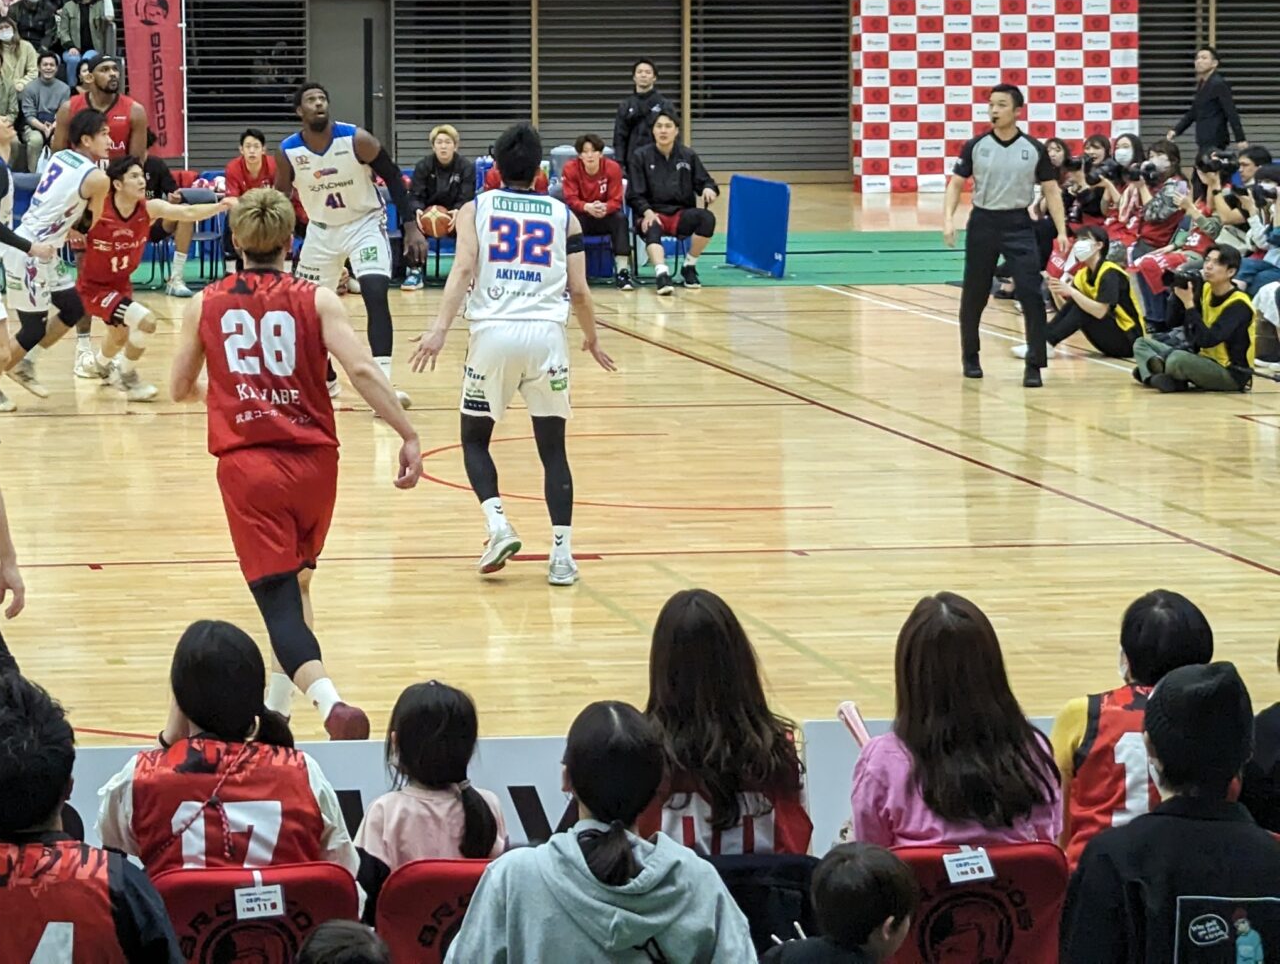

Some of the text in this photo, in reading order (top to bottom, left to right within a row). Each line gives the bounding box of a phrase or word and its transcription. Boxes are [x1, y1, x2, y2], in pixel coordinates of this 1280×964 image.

[325, 191, 346, 210] 41
[488, 214, 555, 268] 32
[495, 268, 542, 283] AKIYAMA
[221, 308, 297, 377] 28
[171, 800, 283, 869] 17
